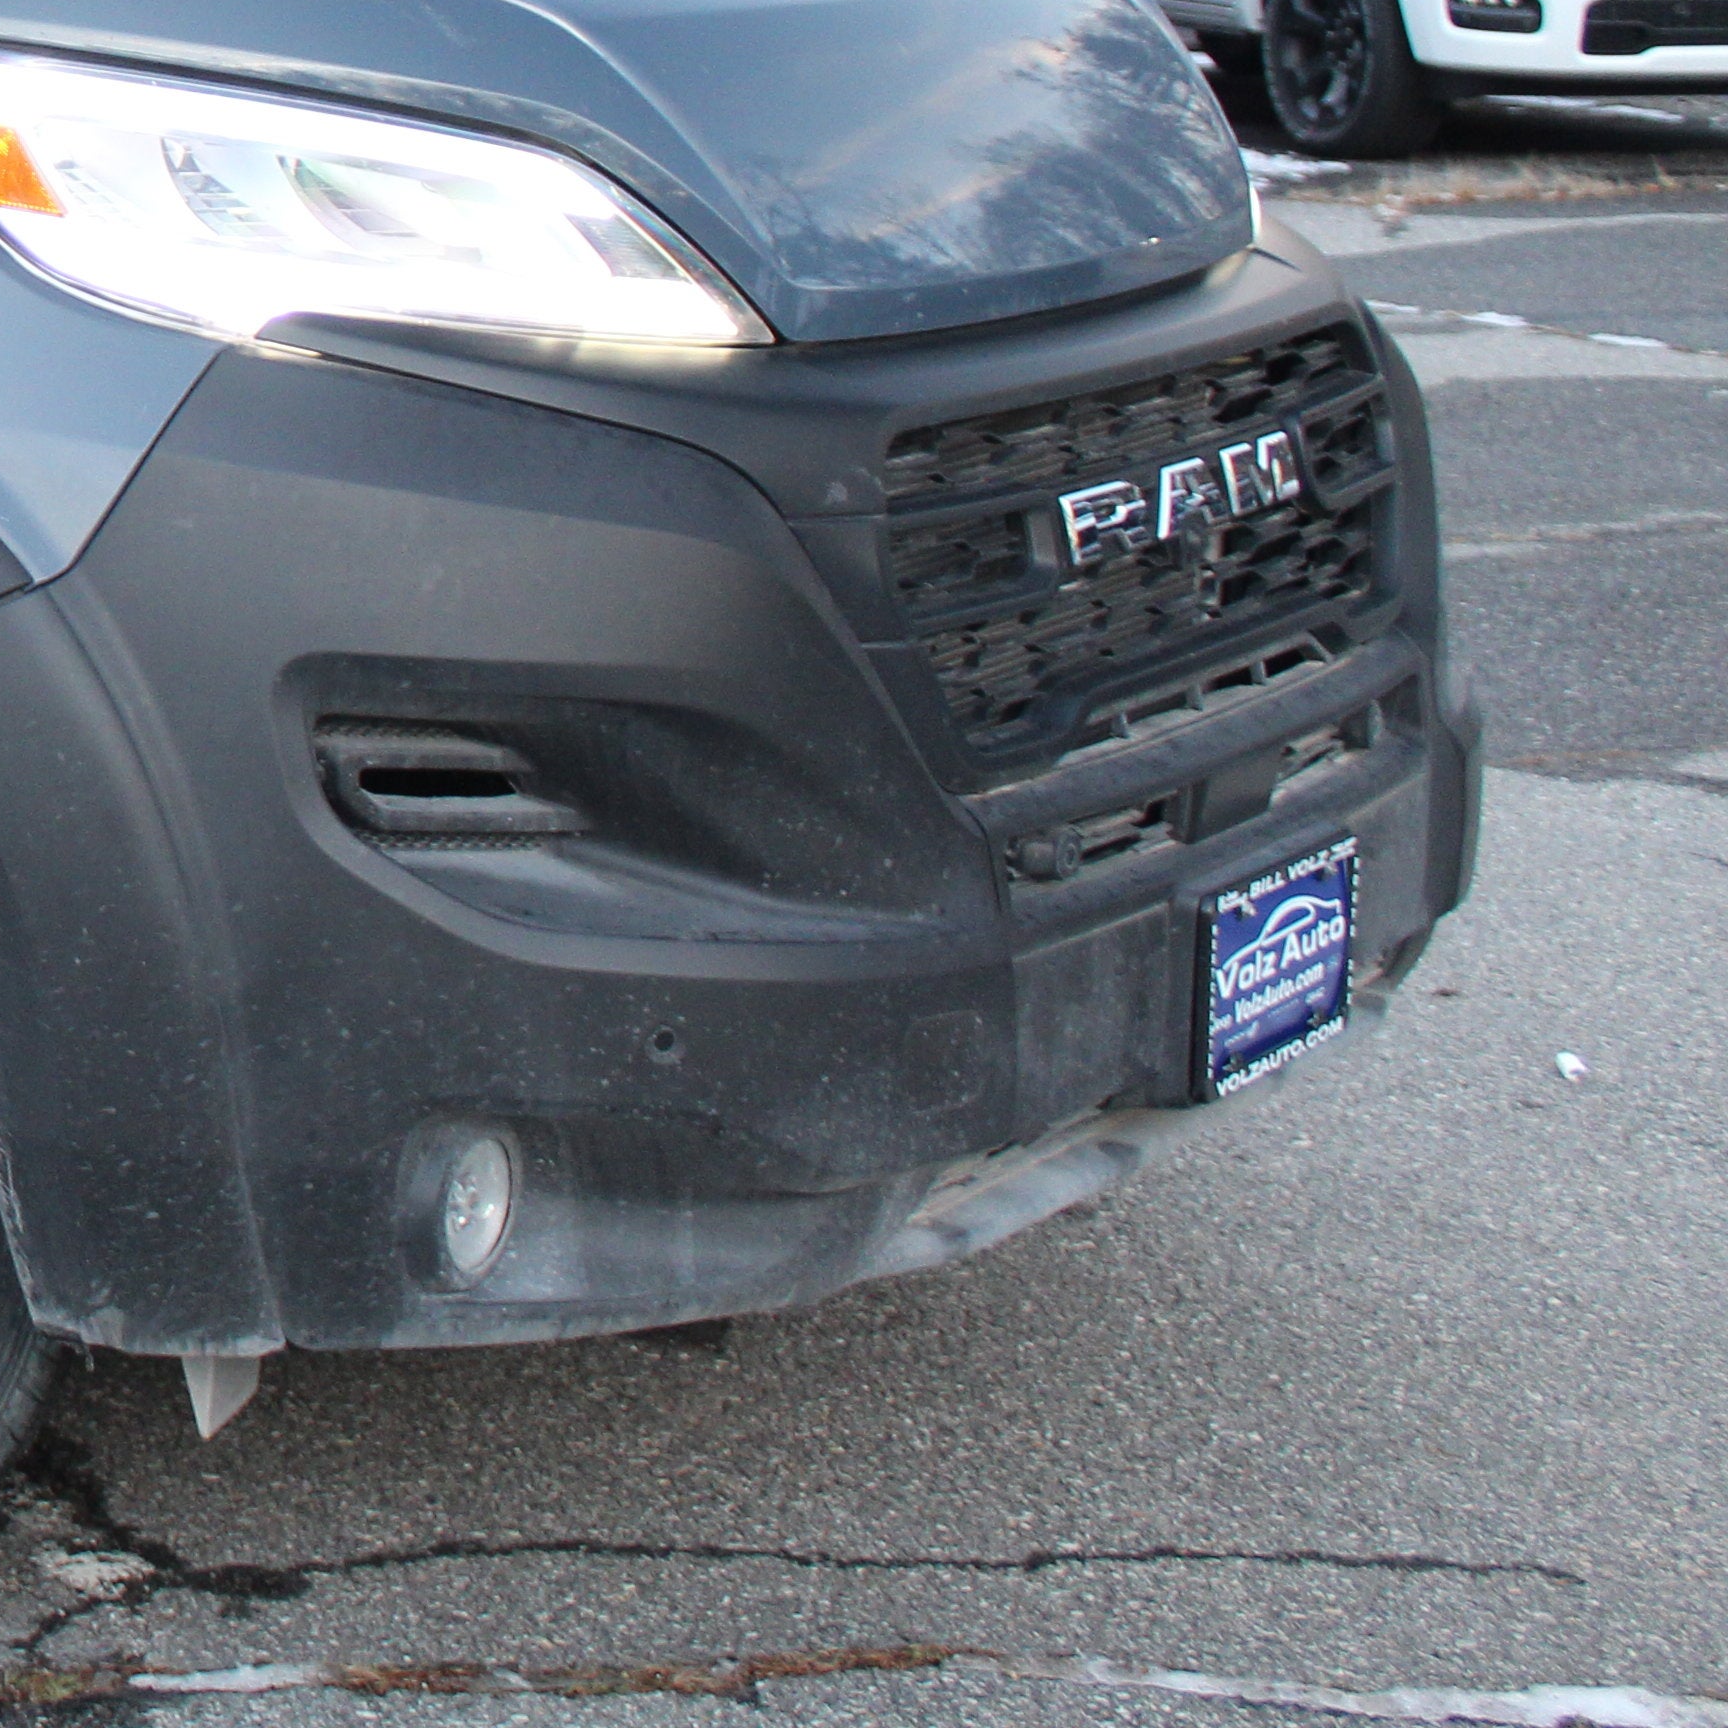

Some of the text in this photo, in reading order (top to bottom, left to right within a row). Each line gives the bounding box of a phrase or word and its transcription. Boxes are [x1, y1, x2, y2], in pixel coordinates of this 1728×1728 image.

[1057, 430, 1301, 566] RAM
[1249, 871, 1287, 900] BILL
[1215, 914, 1346, 999] Volz Auto
[1215, 1015, 1345, 1097] VOLZAUTO.COM
